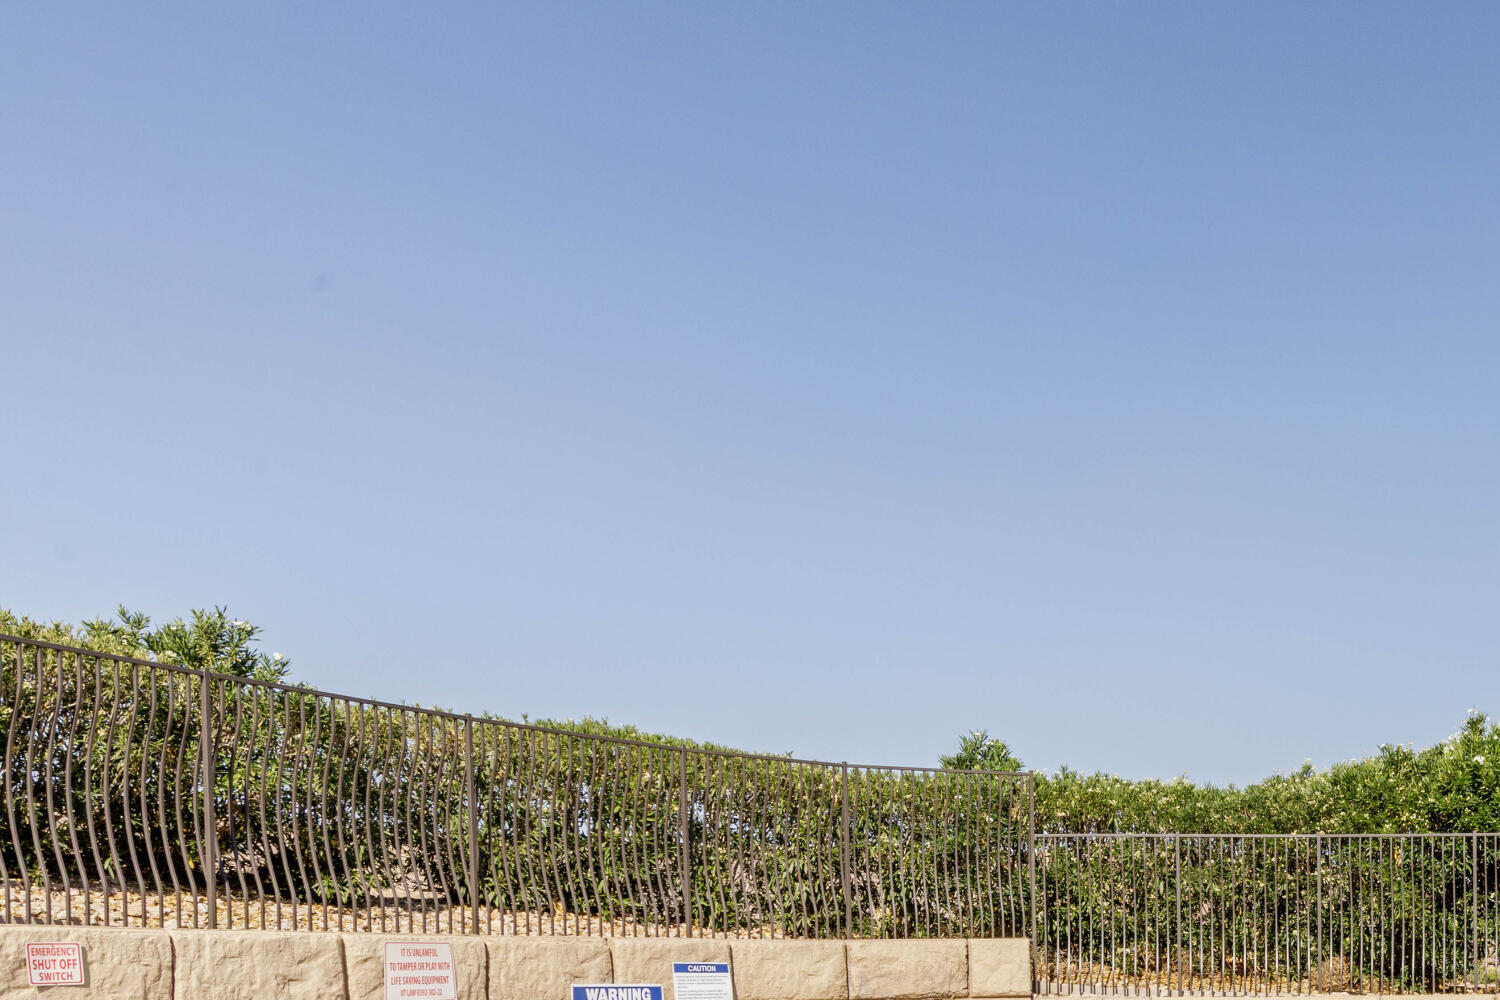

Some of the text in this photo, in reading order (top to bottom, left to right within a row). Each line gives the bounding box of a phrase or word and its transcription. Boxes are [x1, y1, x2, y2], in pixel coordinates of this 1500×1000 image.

[31, 947, 76, 956] EMERGENCY
[401, 948, 439, 957] IT IS UNLAWFUL
[32, 959, 78, 970] SHUT OFF
[390, 962, 450, 971] TO TAMPER OR PLAY WITH
[39, 972, 73, 981] SWITCH
[391, 975, 449, 985] LIFE SAVING EQUIPMENT
